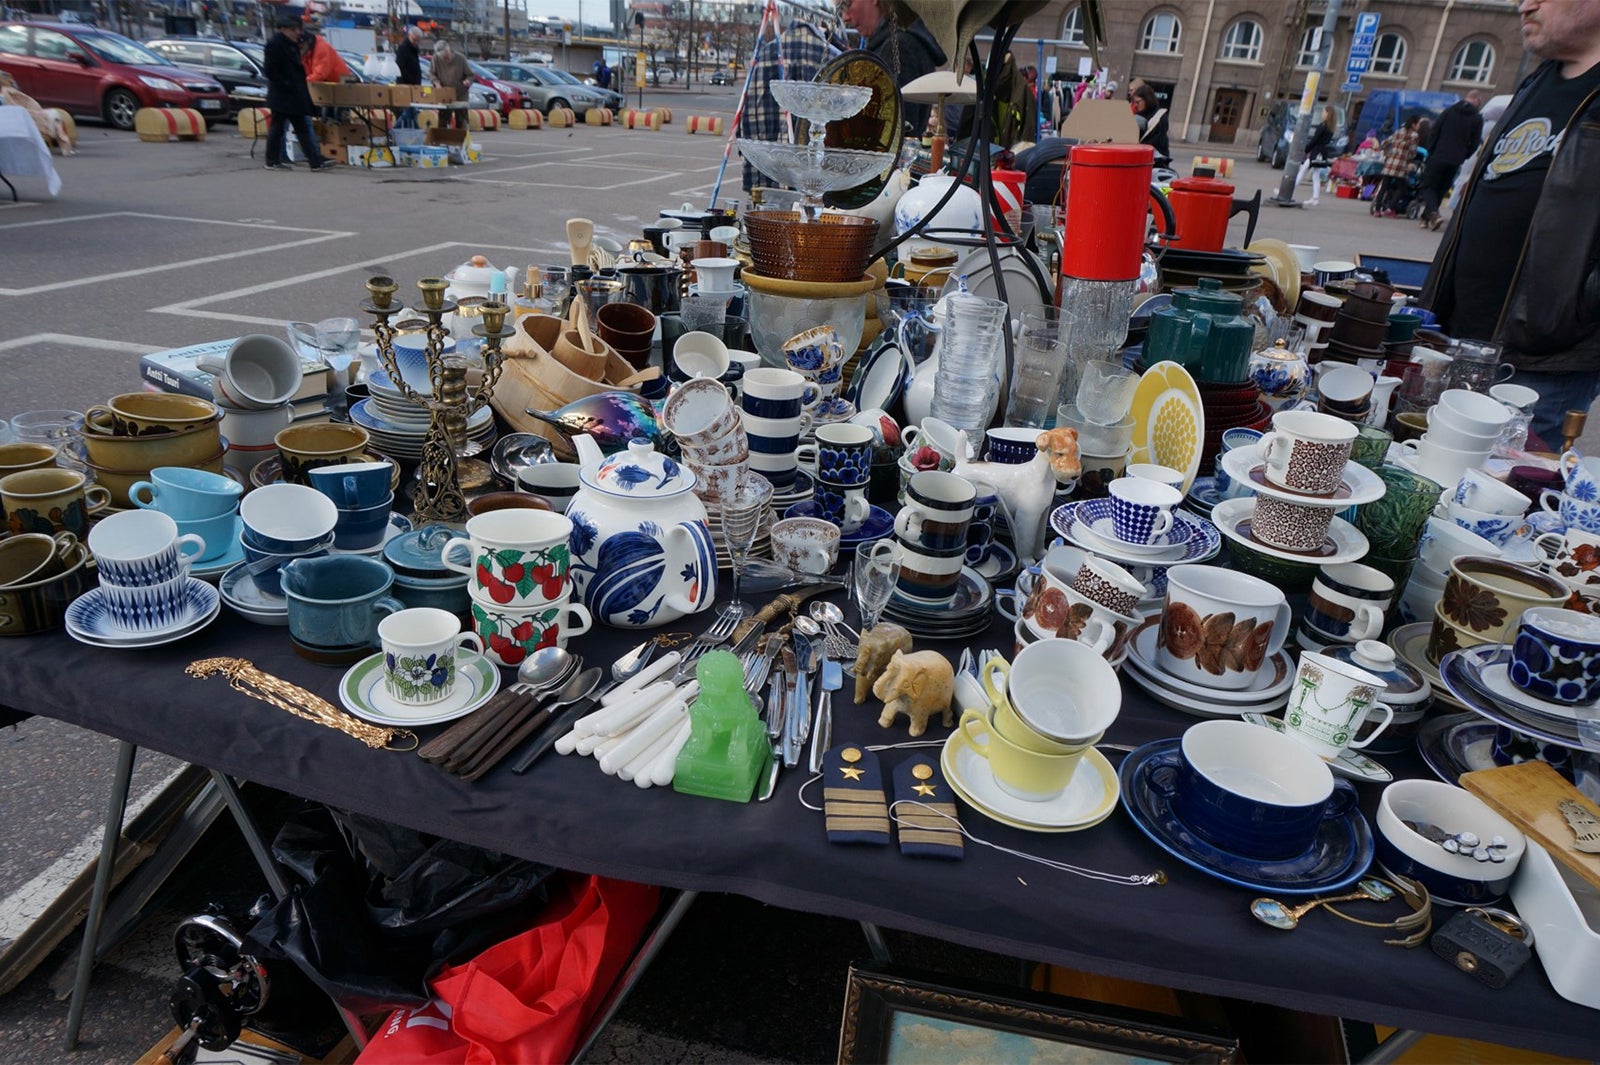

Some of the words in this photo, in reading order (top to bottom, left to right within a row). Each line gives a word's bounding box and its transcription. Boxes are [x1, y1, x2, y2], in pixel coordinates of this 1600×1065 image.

[1360, 14, 1377, 33] P
[1494, 130, 1530, 155] ard
[146, 366, 163, 383] Antti
[163, 373, 180, 390] Tuuri
